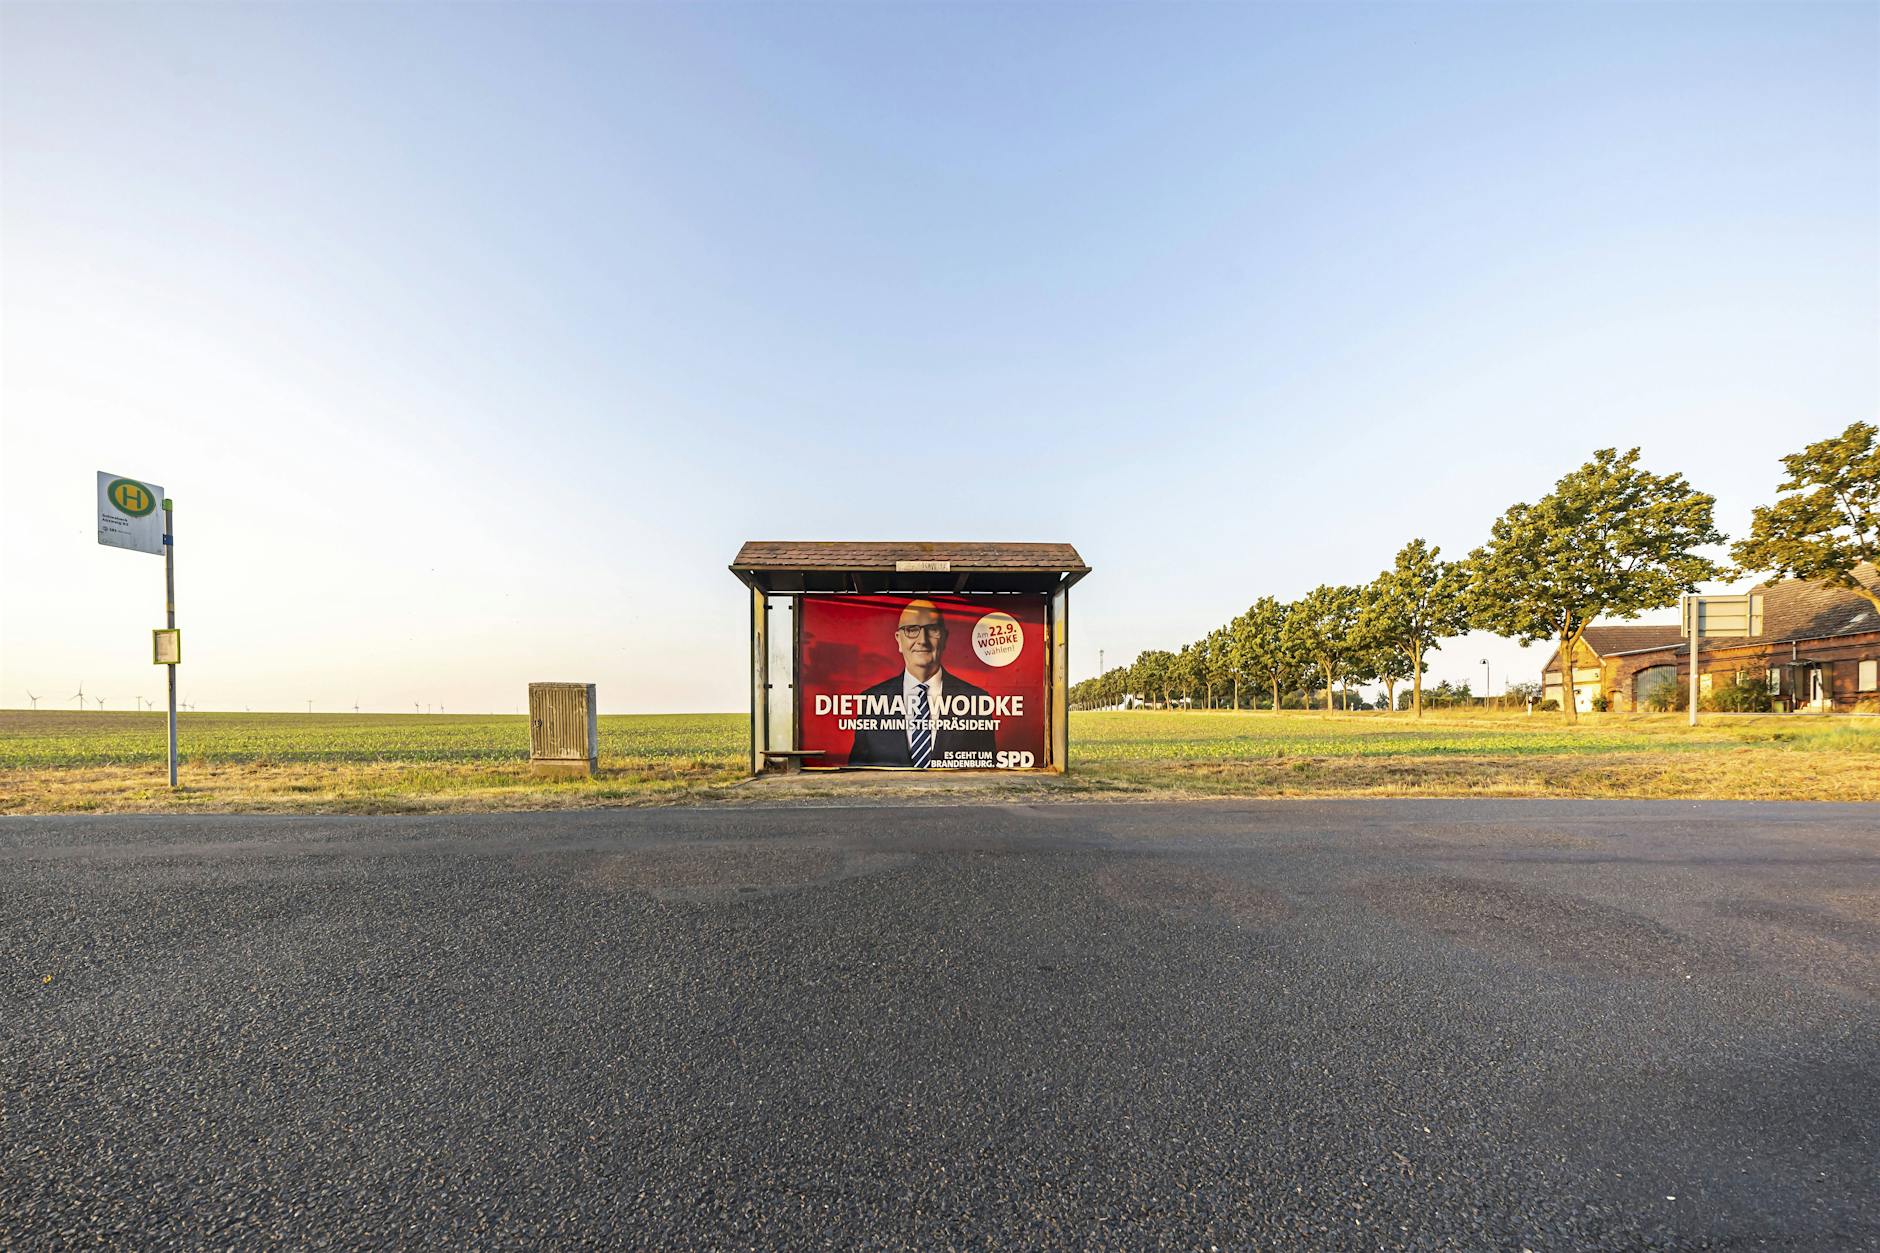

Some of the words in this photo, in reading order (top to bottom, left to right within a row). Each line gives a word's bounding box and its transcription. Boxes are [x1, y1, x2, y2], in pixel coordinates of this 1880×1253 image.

[122, 486, 142, 509] H
[989, 623, 1017, 637] 22.9.
[977, 634, 1018, 649] WOIDKE
[984, 645, 1015, 656] wählen!
[815, 694, 921, 716] DIETMAR
[927, 694, 1024, 717] WOIDKE
[838, 719, 878, 731] UNSER
[880, 717, 1001, 731] MINISTERPRÄSIDENT
[944, 751, 954, 759] ES
[955, 751, 977, 759] GEHT
[978, 751, 993, 759] UM
[996, 751, 1035, 768] SPD
[931, 760, 995, 768] BRANDENBURG.
